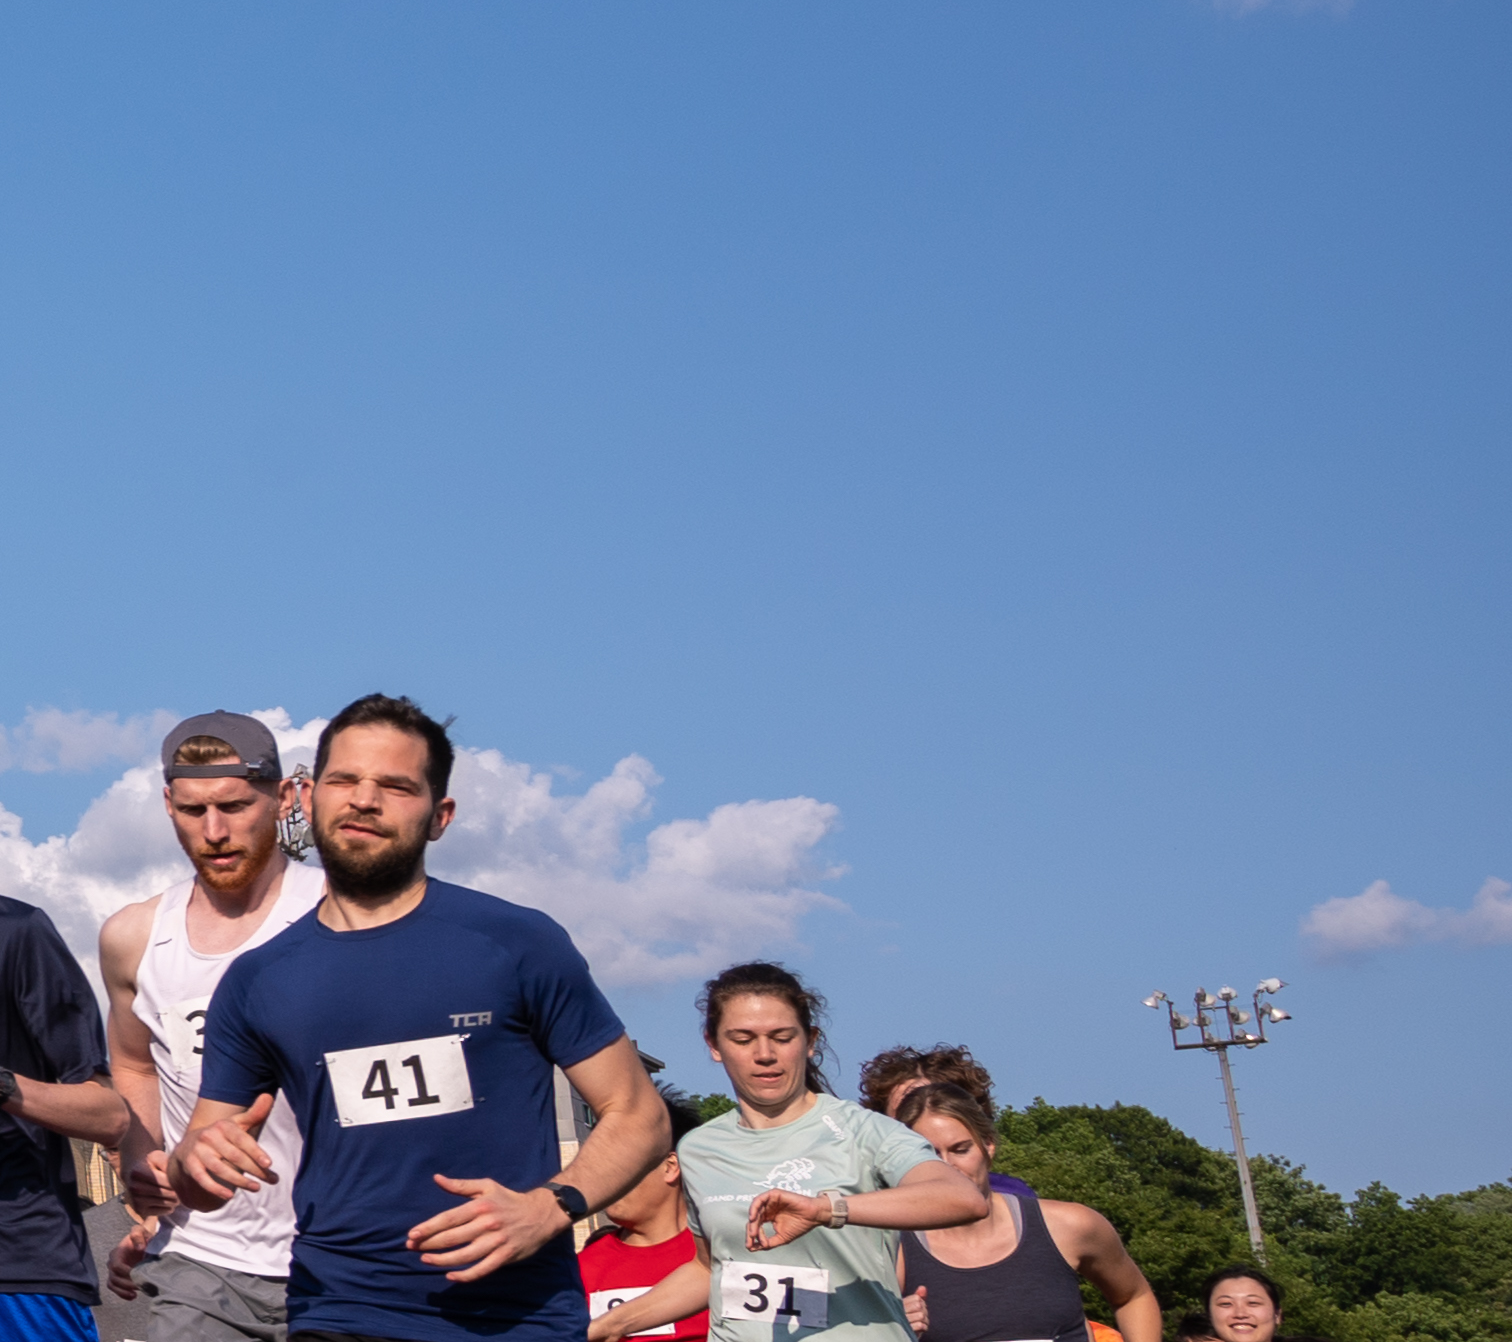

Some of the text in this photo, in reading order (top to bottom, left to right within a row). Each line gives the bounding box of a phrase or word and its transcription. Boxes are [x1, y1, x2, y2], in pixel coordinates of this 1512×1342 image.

[449, 1010, 493, 1028] TCA
[361, 1054, 441, 1110] 41
[742, 1272, 802, 1317] 31
